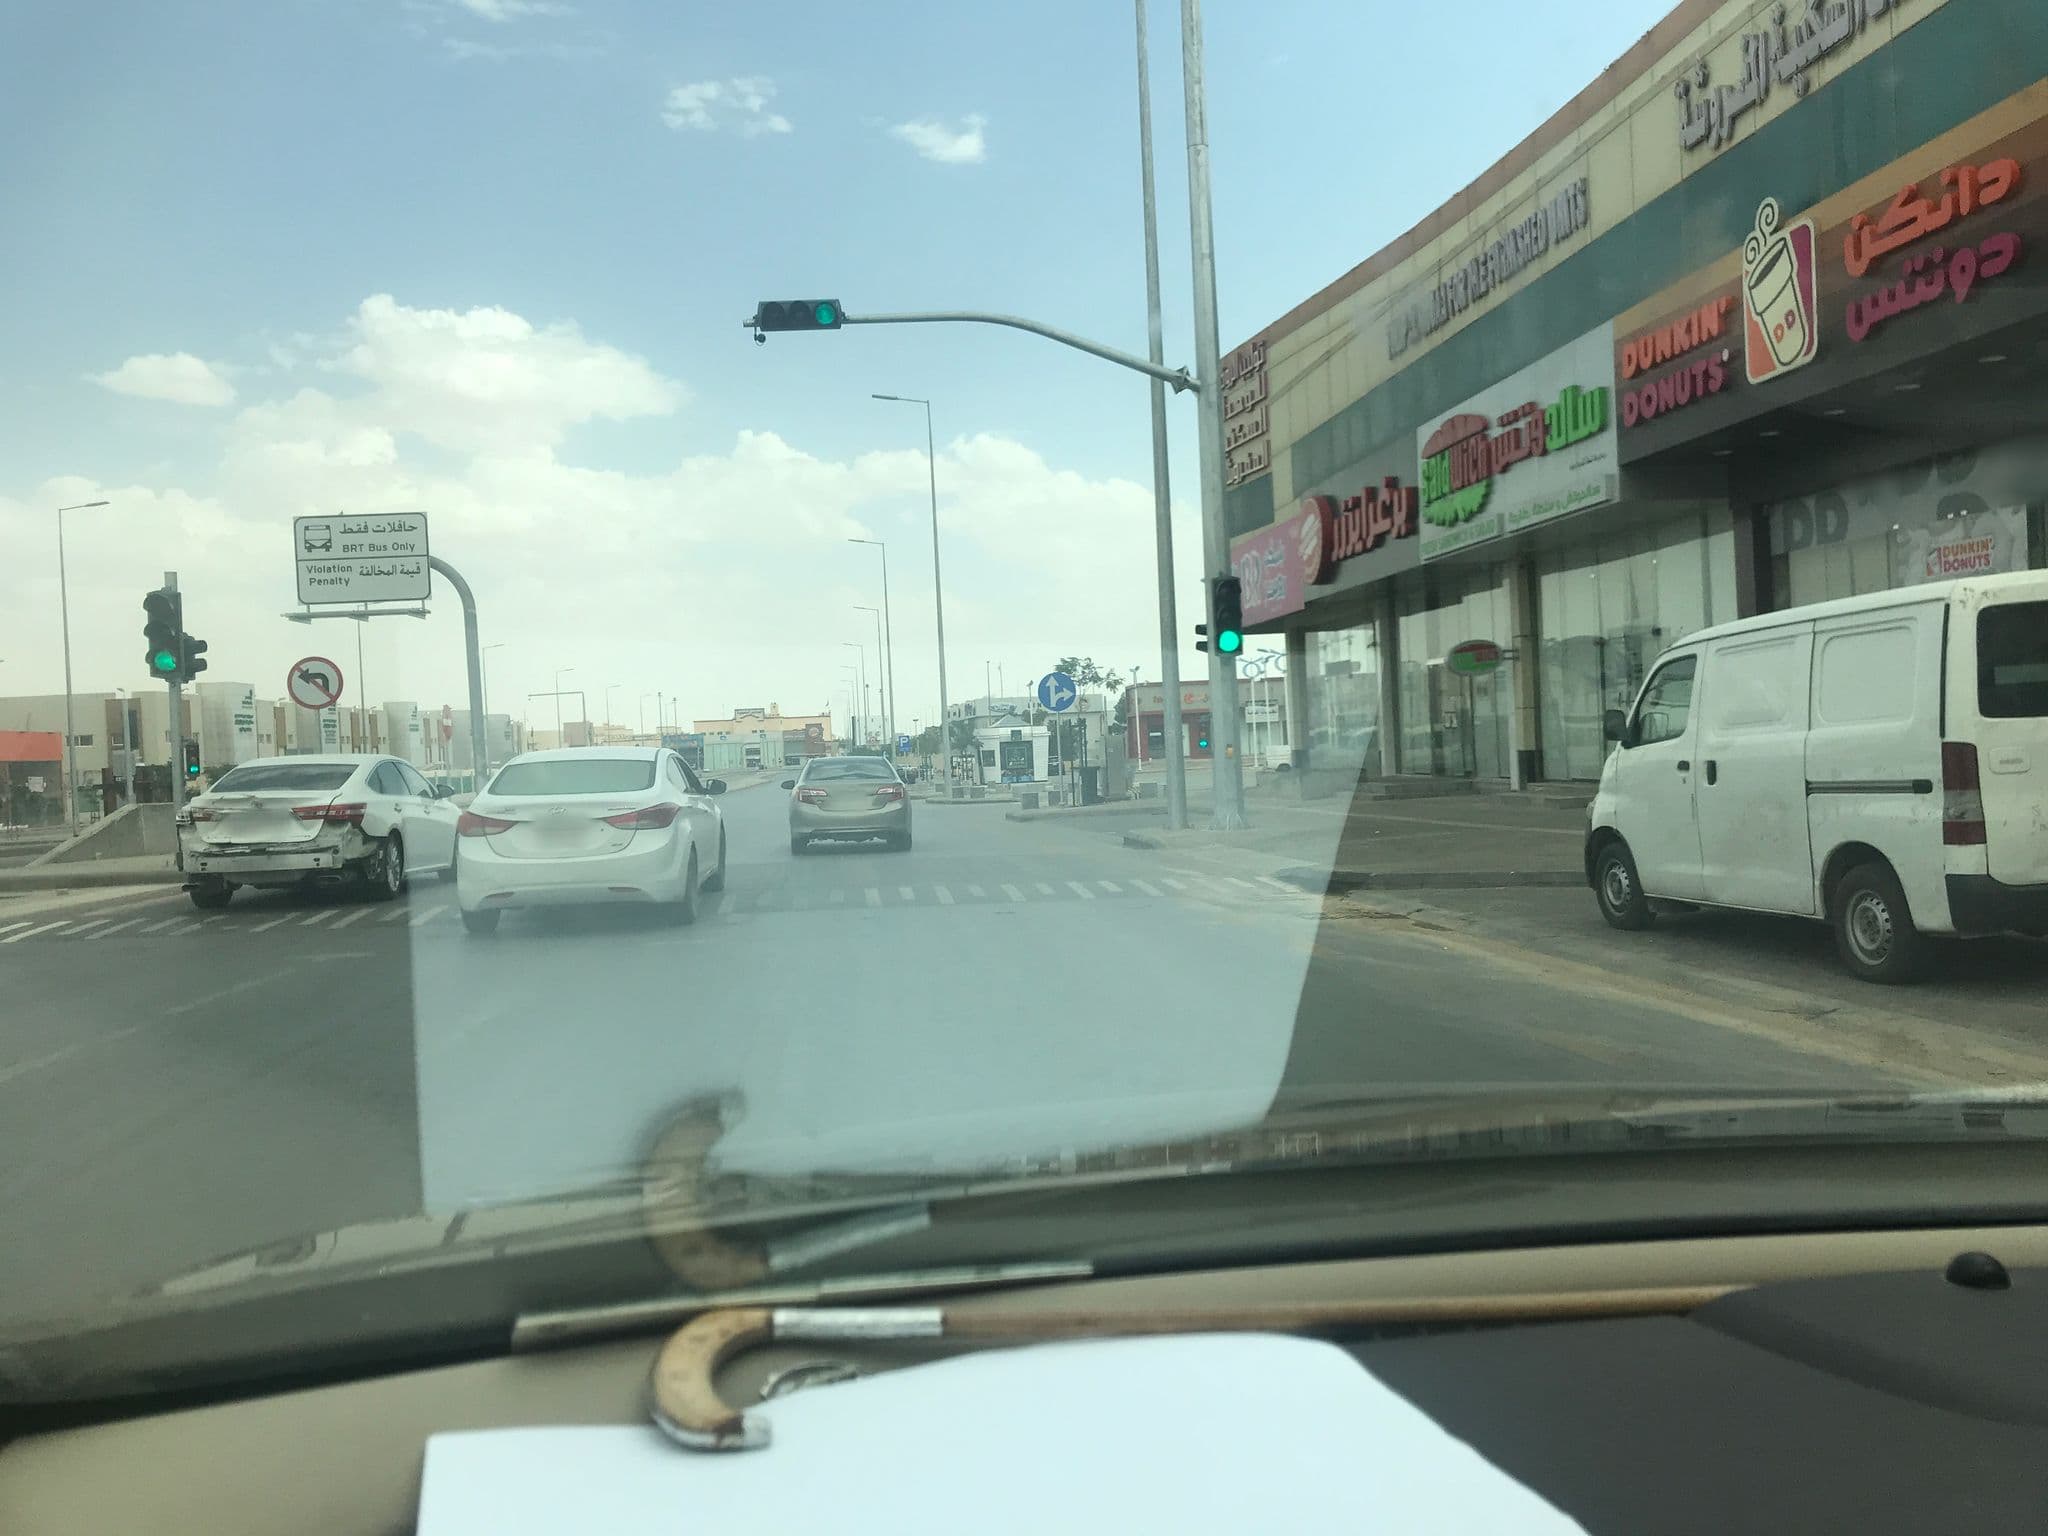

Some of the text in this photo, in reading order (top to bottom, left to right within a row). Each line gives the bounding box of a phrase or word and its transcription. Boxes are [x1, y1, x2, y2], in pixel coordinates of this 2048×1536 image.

[1844, 158, 2021, 277] دانكن
[1846, 231, 2022, 342] دونتس
[339, 520, 418, 535] حافلات فقط
[342, 542, 416, 553] BRT Bus Only
[306, 564, 353, 574] Violation
[359, 562, 421, 578] قيمة المخالفة
[1944, 554, 1991, 573] DONUTS
[309, 577, 350, 587] Penalty
